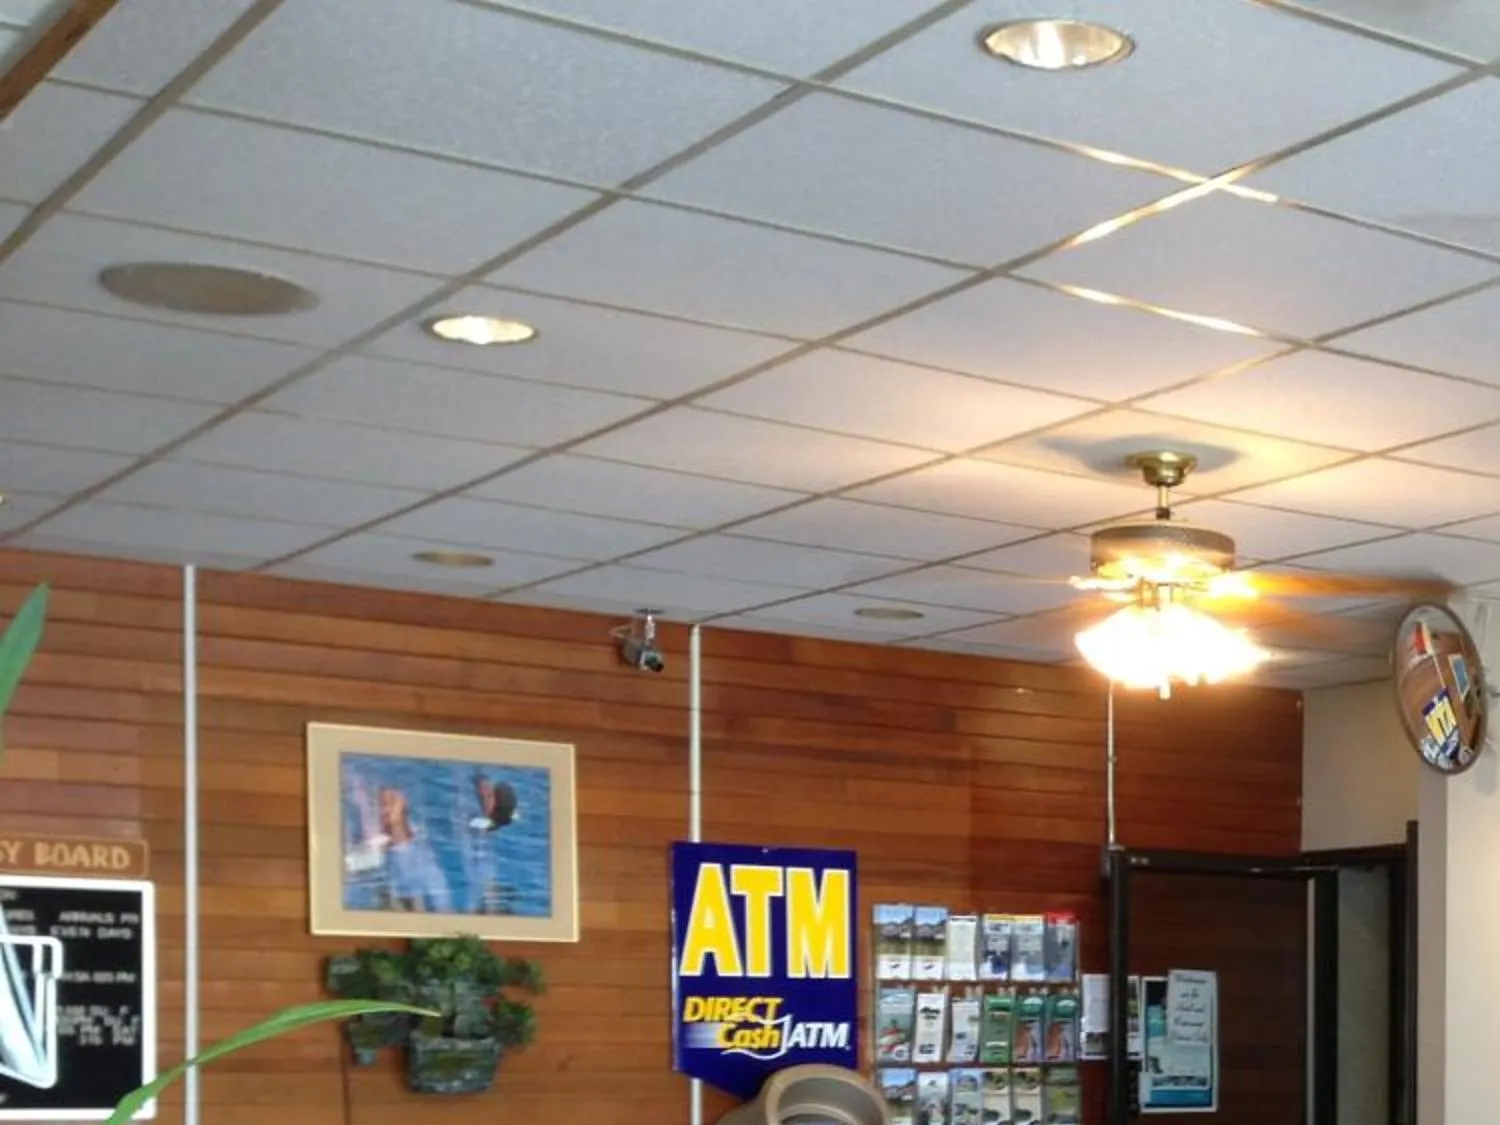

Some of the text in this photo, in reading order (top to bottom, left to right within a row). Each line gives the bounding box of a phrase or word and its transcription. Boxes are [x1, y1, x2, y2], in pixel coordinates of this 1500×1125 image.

[0, 840, 131, 870] Y BOARD
[679, 862, 851, 979] ATM
[683, 996, 783, 1024] DIRECT
[716, 1021, 852, 1050] Cash ATM
